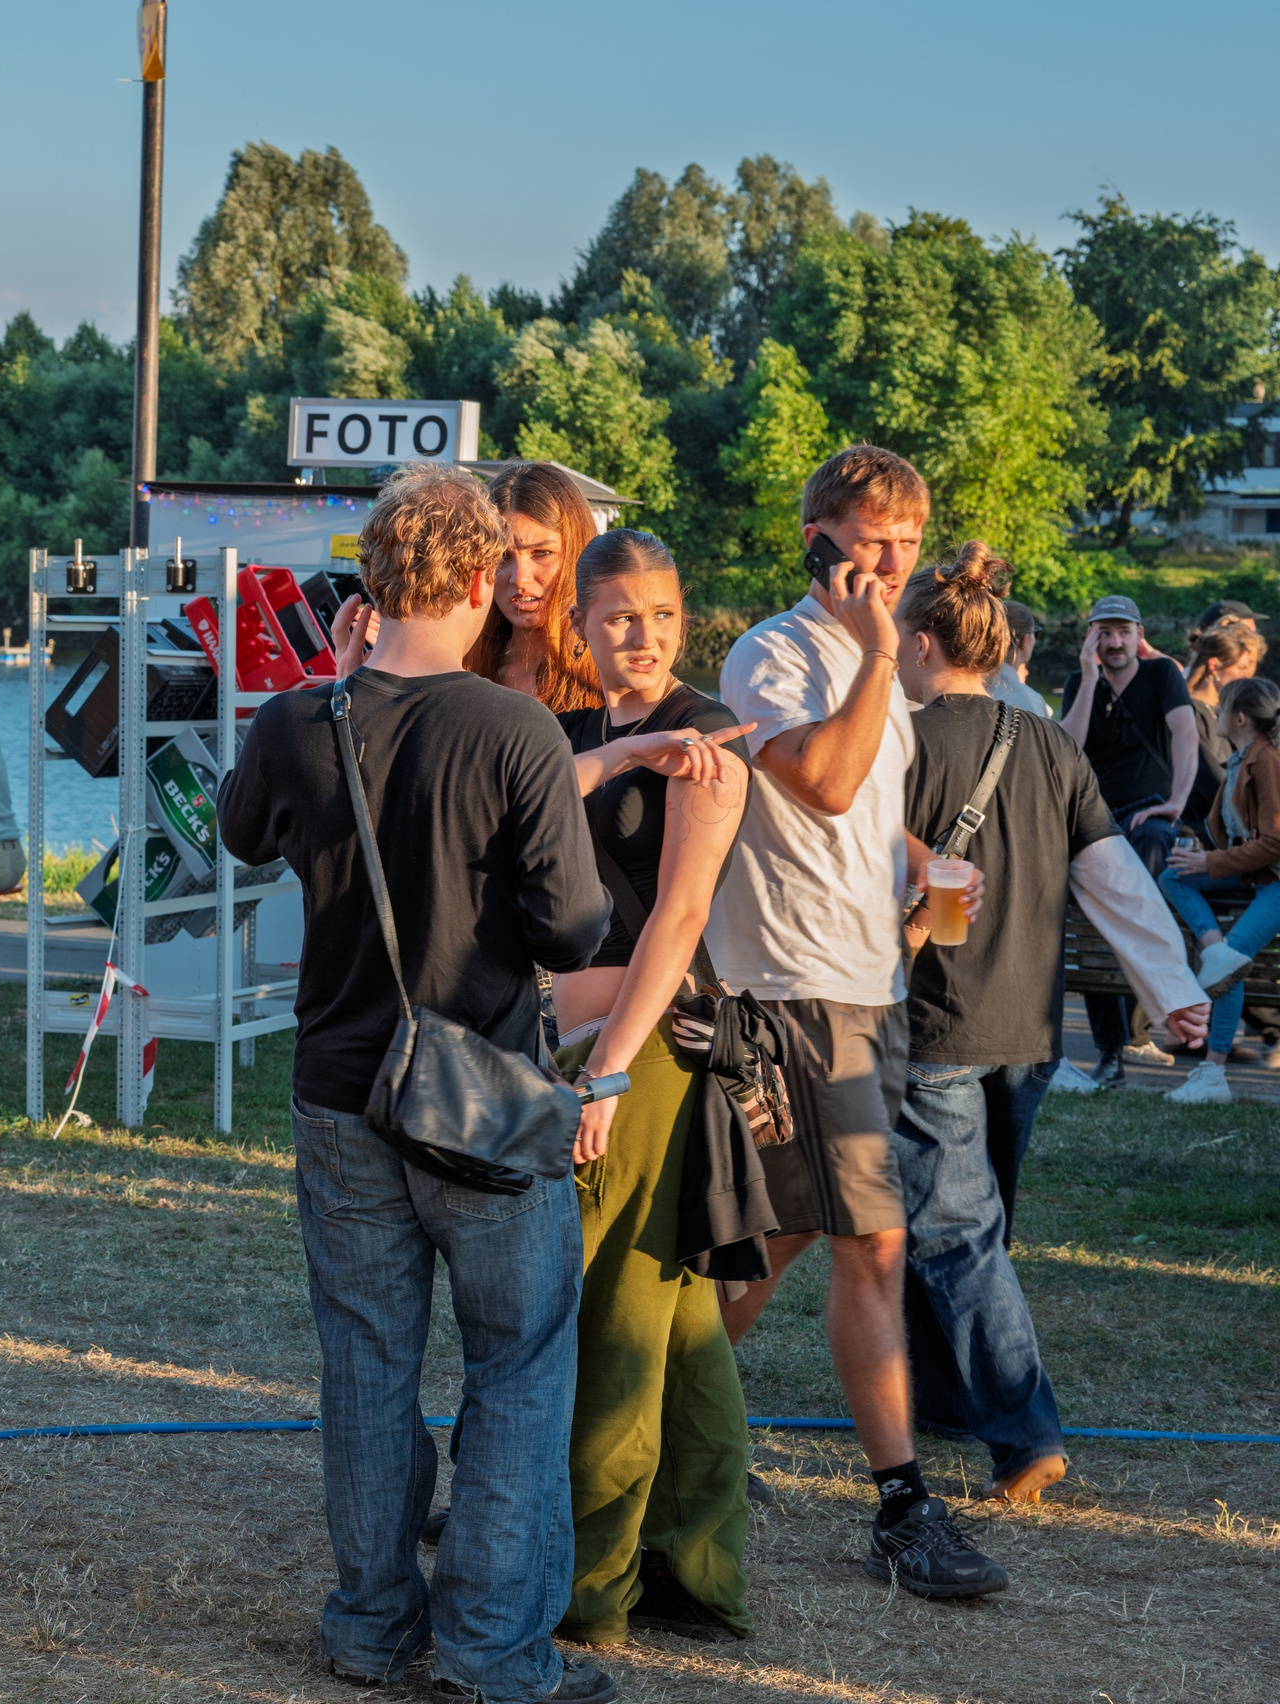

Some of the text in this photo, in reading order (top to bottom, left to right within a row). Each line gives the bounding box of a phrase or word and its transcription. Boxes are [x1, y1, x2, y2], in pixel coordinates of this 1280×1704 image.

[306, 413, 448, 457] FOTO
[163, 779, 210, 843] BECK'S
[145, 851, 171, 887] CK'S
